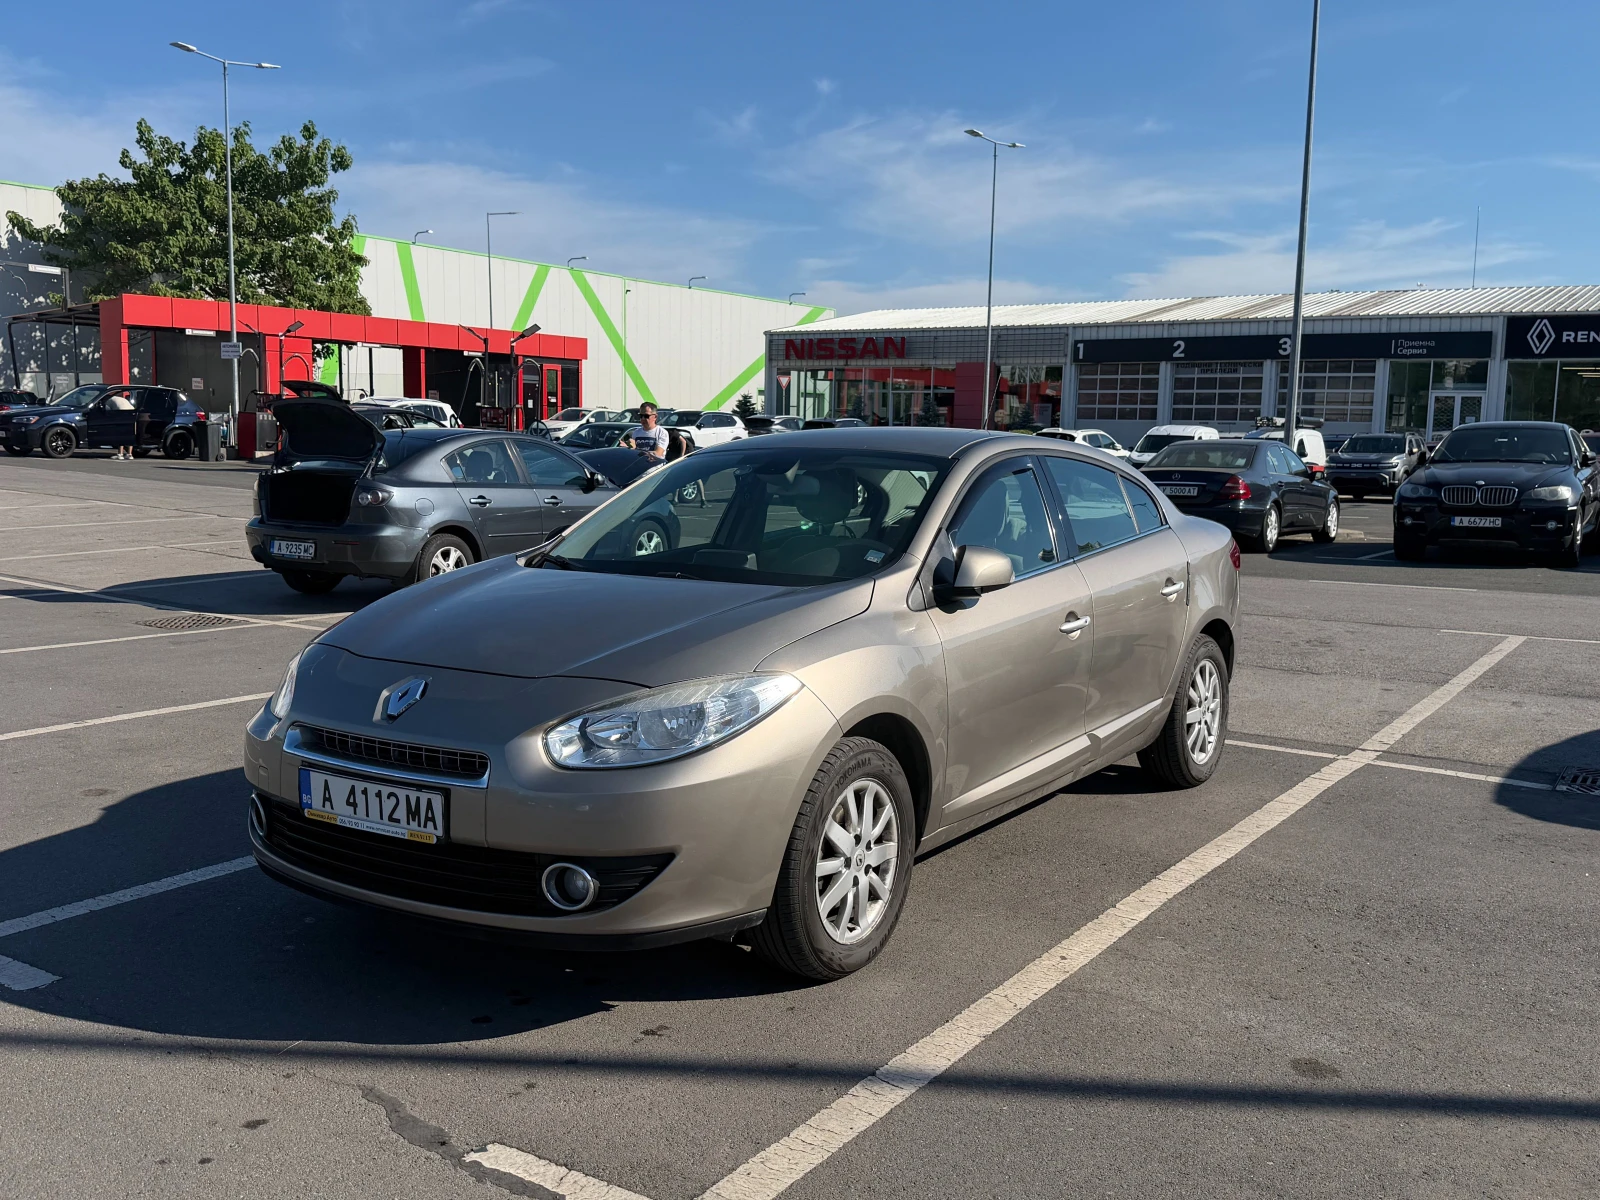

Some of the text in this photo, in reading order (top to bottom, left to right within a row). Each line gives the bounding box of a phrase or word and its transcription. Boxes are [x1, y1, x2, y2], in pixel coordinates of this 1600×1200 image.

[1398, 340, 1435, 348] Приемна
[1562, 330, 1600, 343] REN
[785, 336, 906, 360] NISSAN
[1077, 342, 1084, 359] 1
[1172, 340, 1185, 357] 2
[1278, 337, 1292, 355] 3
[1397, 347, 1427, 355] Сервиз
[835, 757, 872, 789] YOKOHAMA
[303, 793, 312, 804] BG
[322, 779, 334, 810] A
